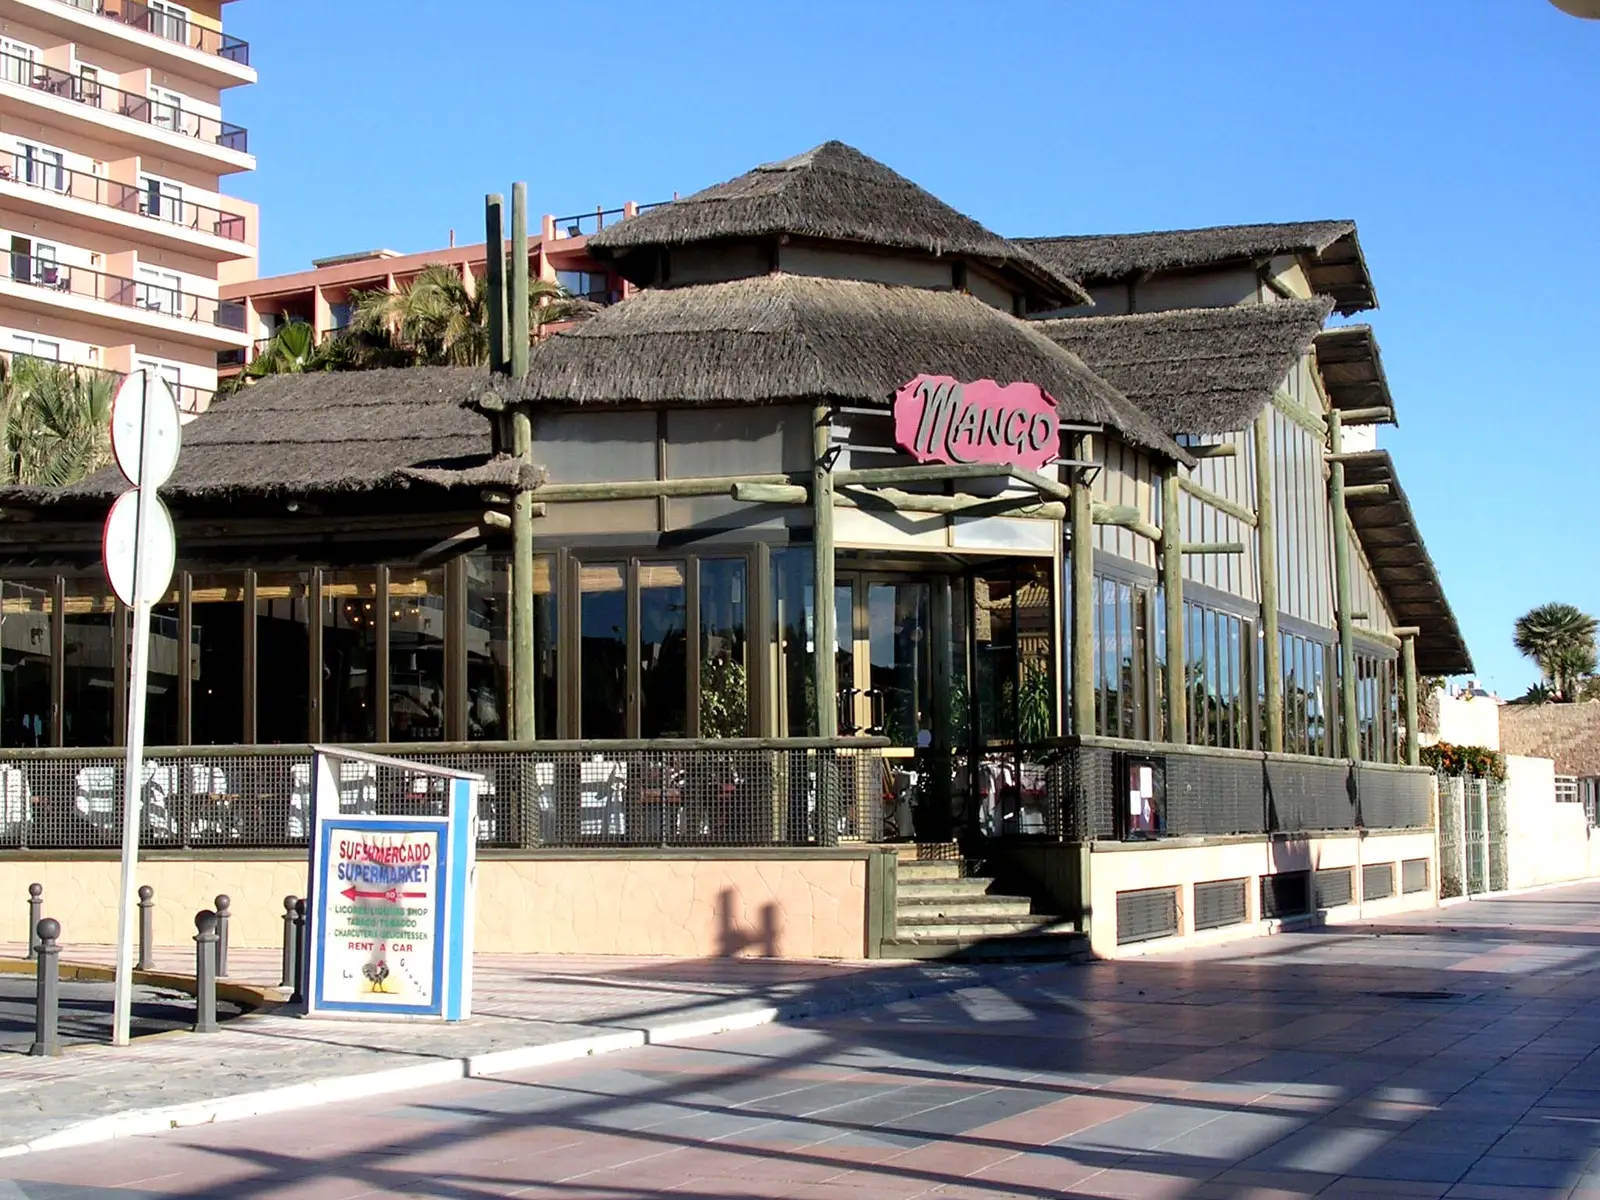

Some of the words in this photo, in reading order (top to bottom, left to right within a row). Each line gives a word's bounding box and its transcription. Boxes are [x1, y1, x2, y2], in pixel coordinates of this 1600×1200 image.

[913, 380, 1053, 463] MANGO
[338, 863, 429, 884] SUPERMARKET
[348, 942, 374, 951] RENT
[379, 943, 386, 951] A
[392, 944, 413, 952] CAR
